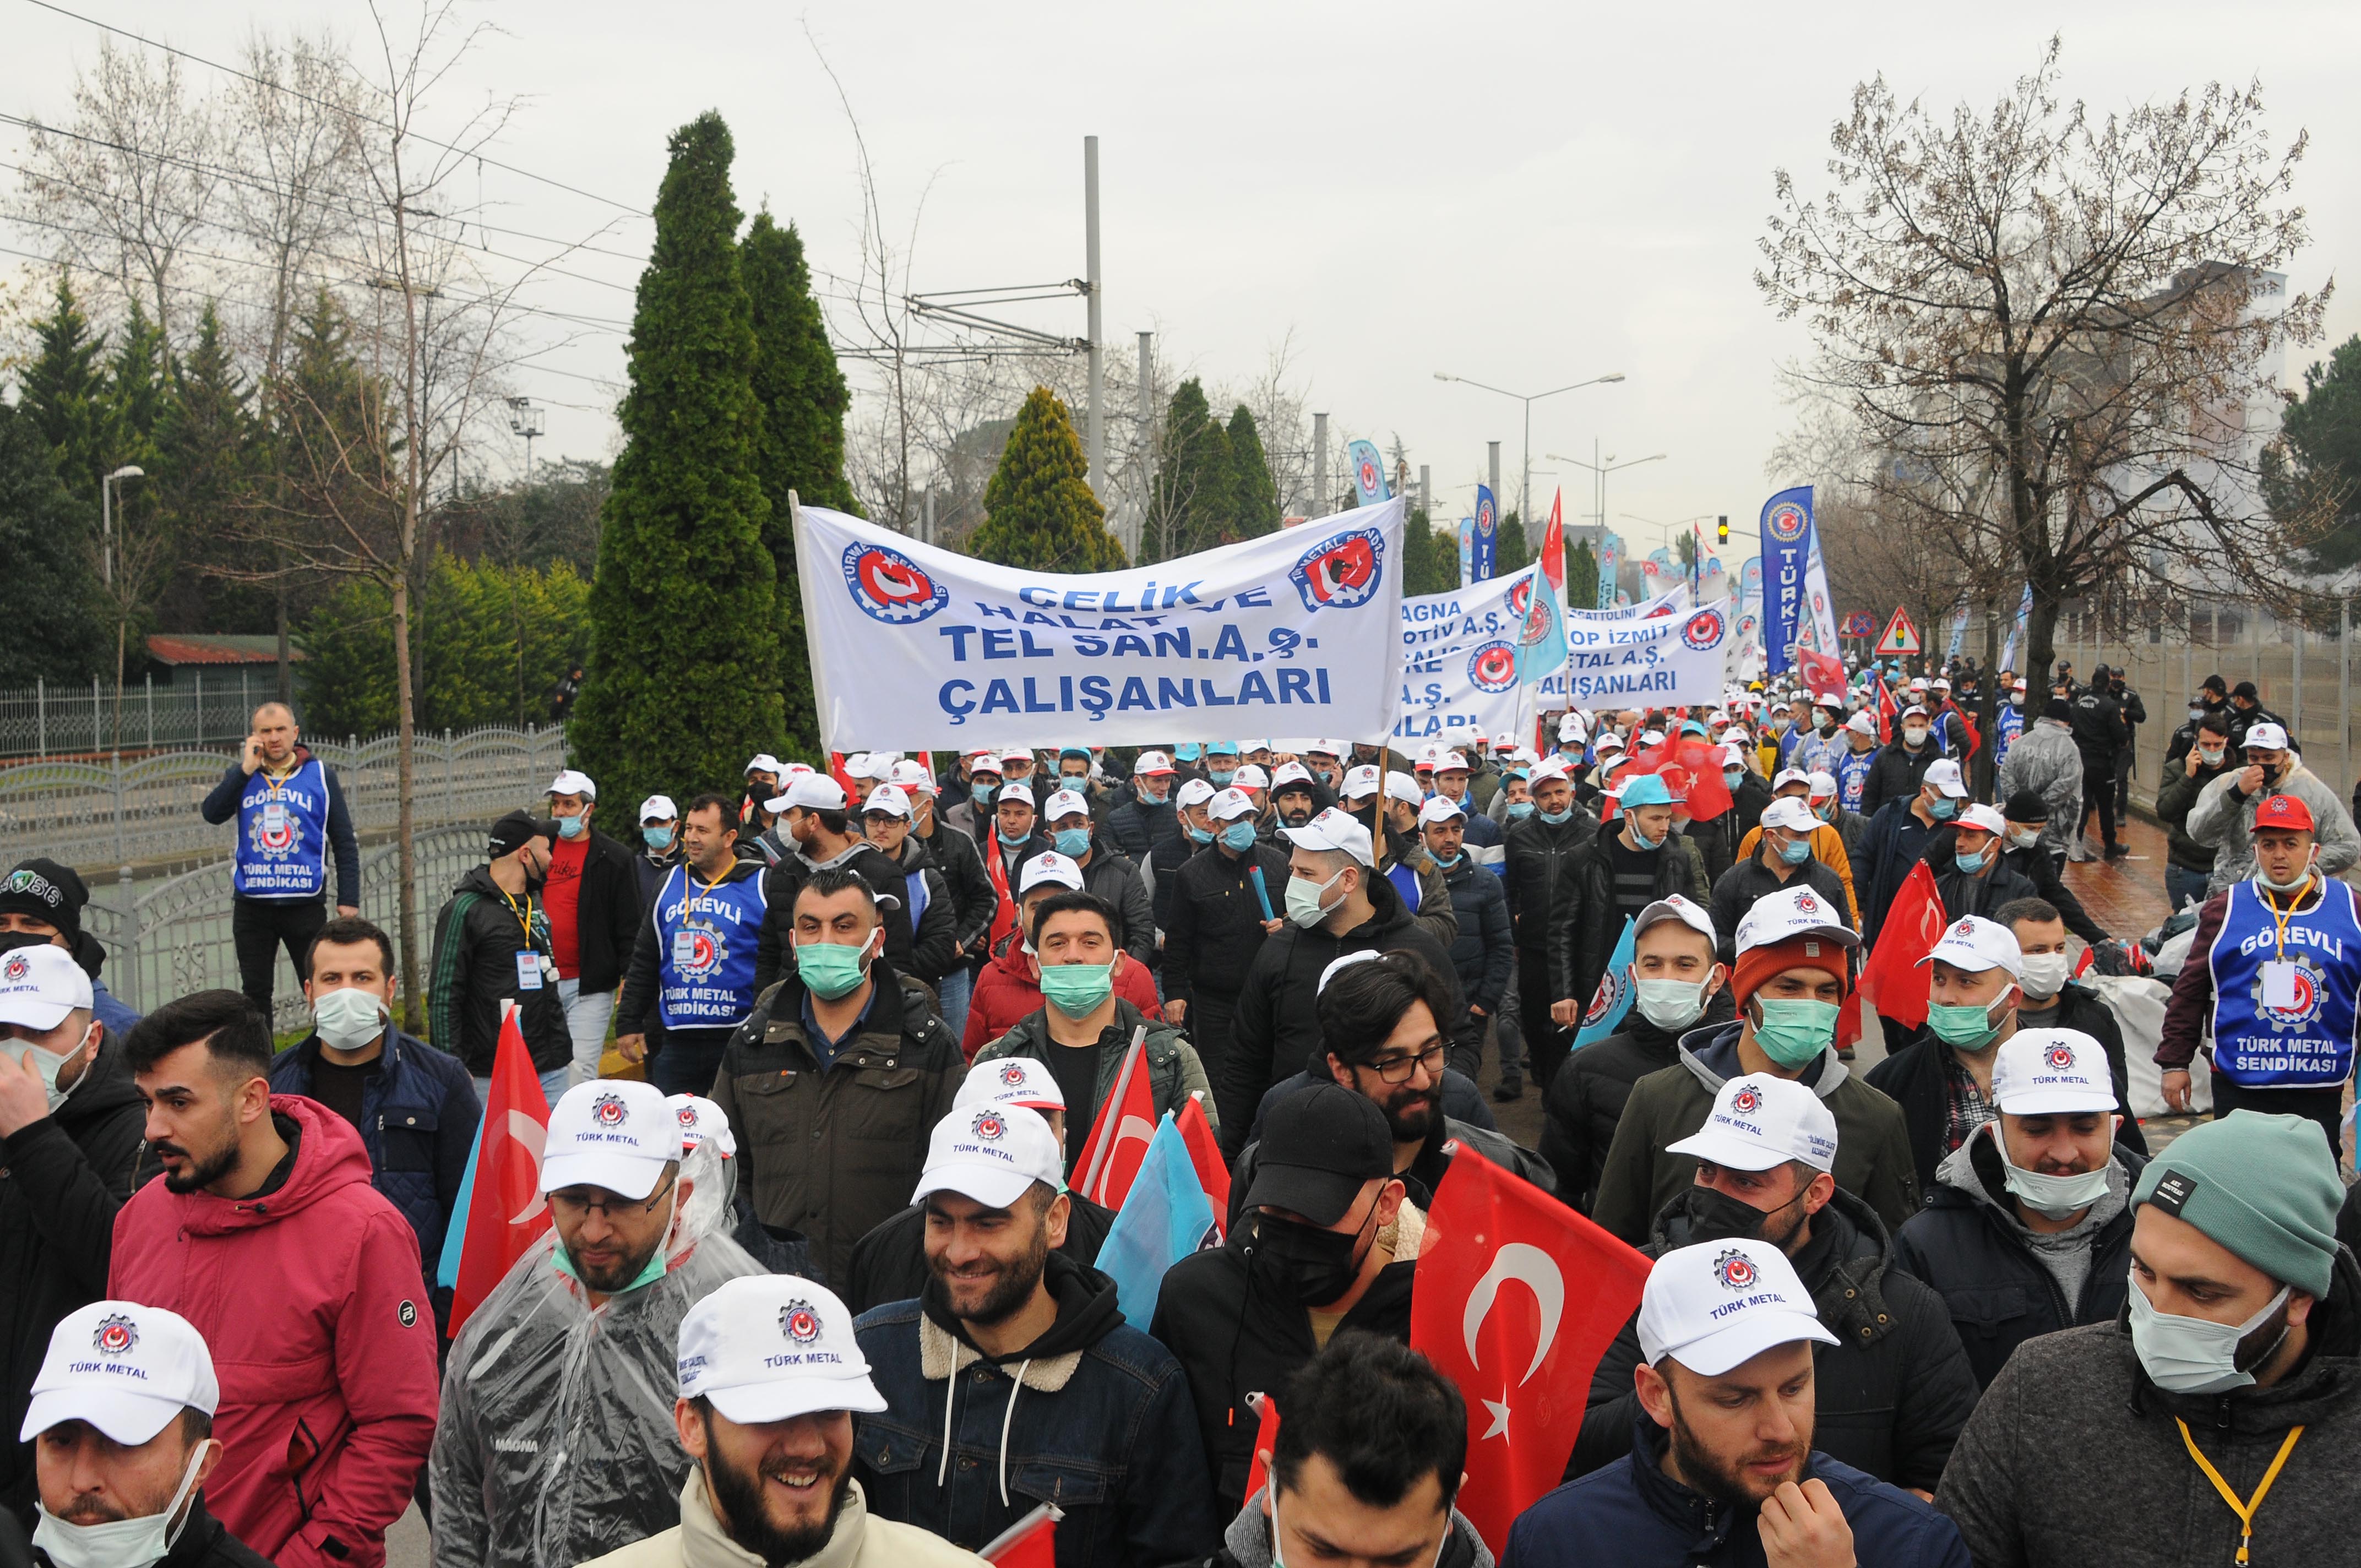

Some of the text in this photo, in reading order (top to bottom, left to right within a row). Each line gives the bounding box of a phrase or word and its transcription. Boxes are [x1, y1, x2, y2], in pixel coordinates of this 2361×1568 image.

[1019, 580, 1205, 612] ÇELİK
[974, 586, 1273, 631] HALAT VE
[1462, 612, 1506, 638] A.Ş.
[1608, 623, 1672, 644] İZMİT
[939, 624, 1319, 662] TEL SAN.A.Ş.
[1622, 645, 1665, 668] A.Ş.
[1536, 671, 1676, 700] ALIŞANLARI
[938, 667, 1332, 725] ÇALIŞANLARI
[242, 788, 312, 813] GÖREVLİ
[275, 864, 312, 876] METAL
[665, 897, 742, 925] GÖREVLİ
[1956, 939, 1975, 949] METAL
[2240, 925, 2342, 961] GÖREVLİ
[665, 986, 737, 1002] TÜRK METAL
[667, 1000, 736, 1017] SENDİKASI
[2237, 1036, 2337, 1054] TÜRK METAL
[2236, 1054, 2336, 1072] SENDİKASI
[2032, 1075, 2090, 1085] TÜRK METAL
[994, 1091, 1015, 1102] TÜRK
[1714, 1113, 1762, 1136] TÜRK METAL
[575, 1130, 639, 1147] TÜRK METAL
[953, 1143, 1014, 1163] TÜRK METAL
[1710, 1293, 1786, 1320] TÜRK METAL
[69, 1360, 148, 1380] TÜRK METAL
[763, 1353, 842, 1369] TÜRK METAL
[495, 1438, 539, 1453] MAGNA
